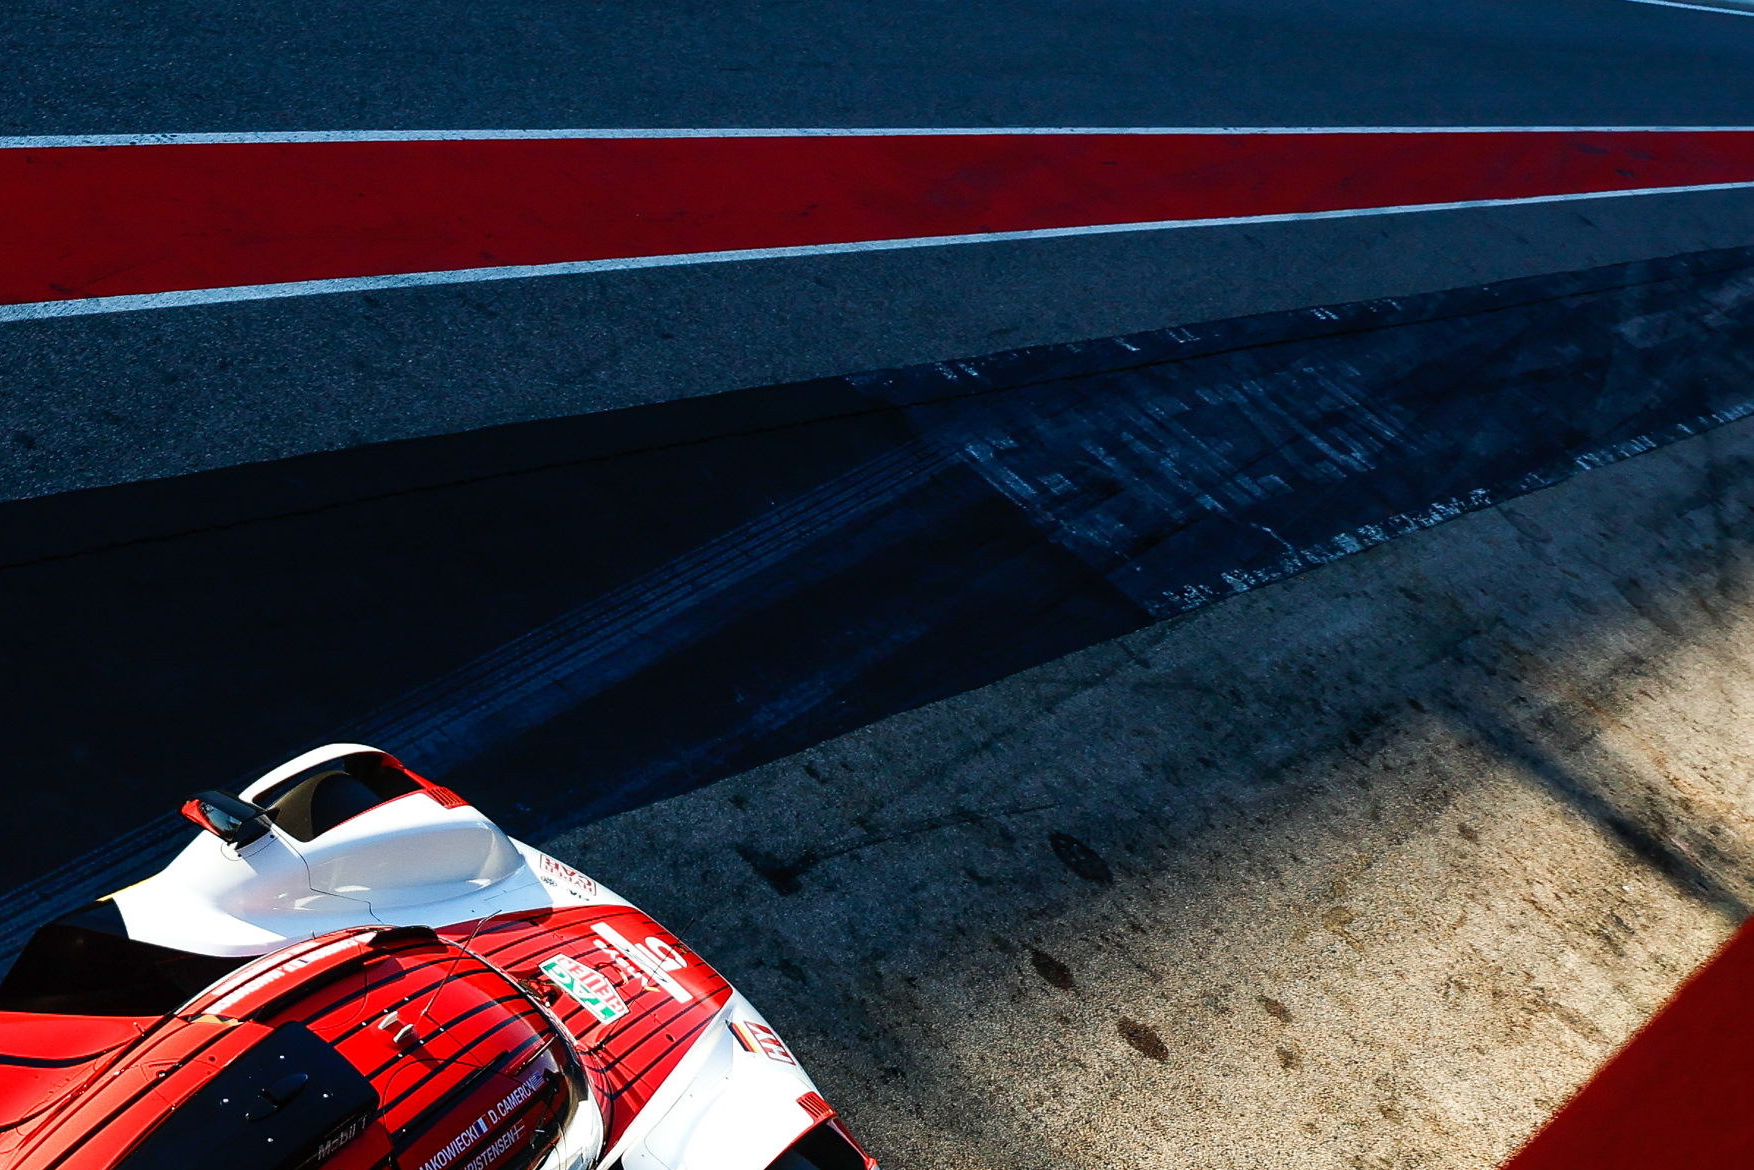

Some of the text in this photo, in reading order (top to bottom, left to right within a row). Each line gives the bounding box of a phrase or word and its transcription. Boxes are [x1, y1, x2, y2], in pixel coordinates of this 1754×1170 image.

[547, 964, 609, 1020] TAG
[559, 956, 625, 1012] HEUER
[592, 937, 661, 993] Ansys
[318, 1123, 357, 1160] Mobil
[487, 1109, 501, 1124] D.
